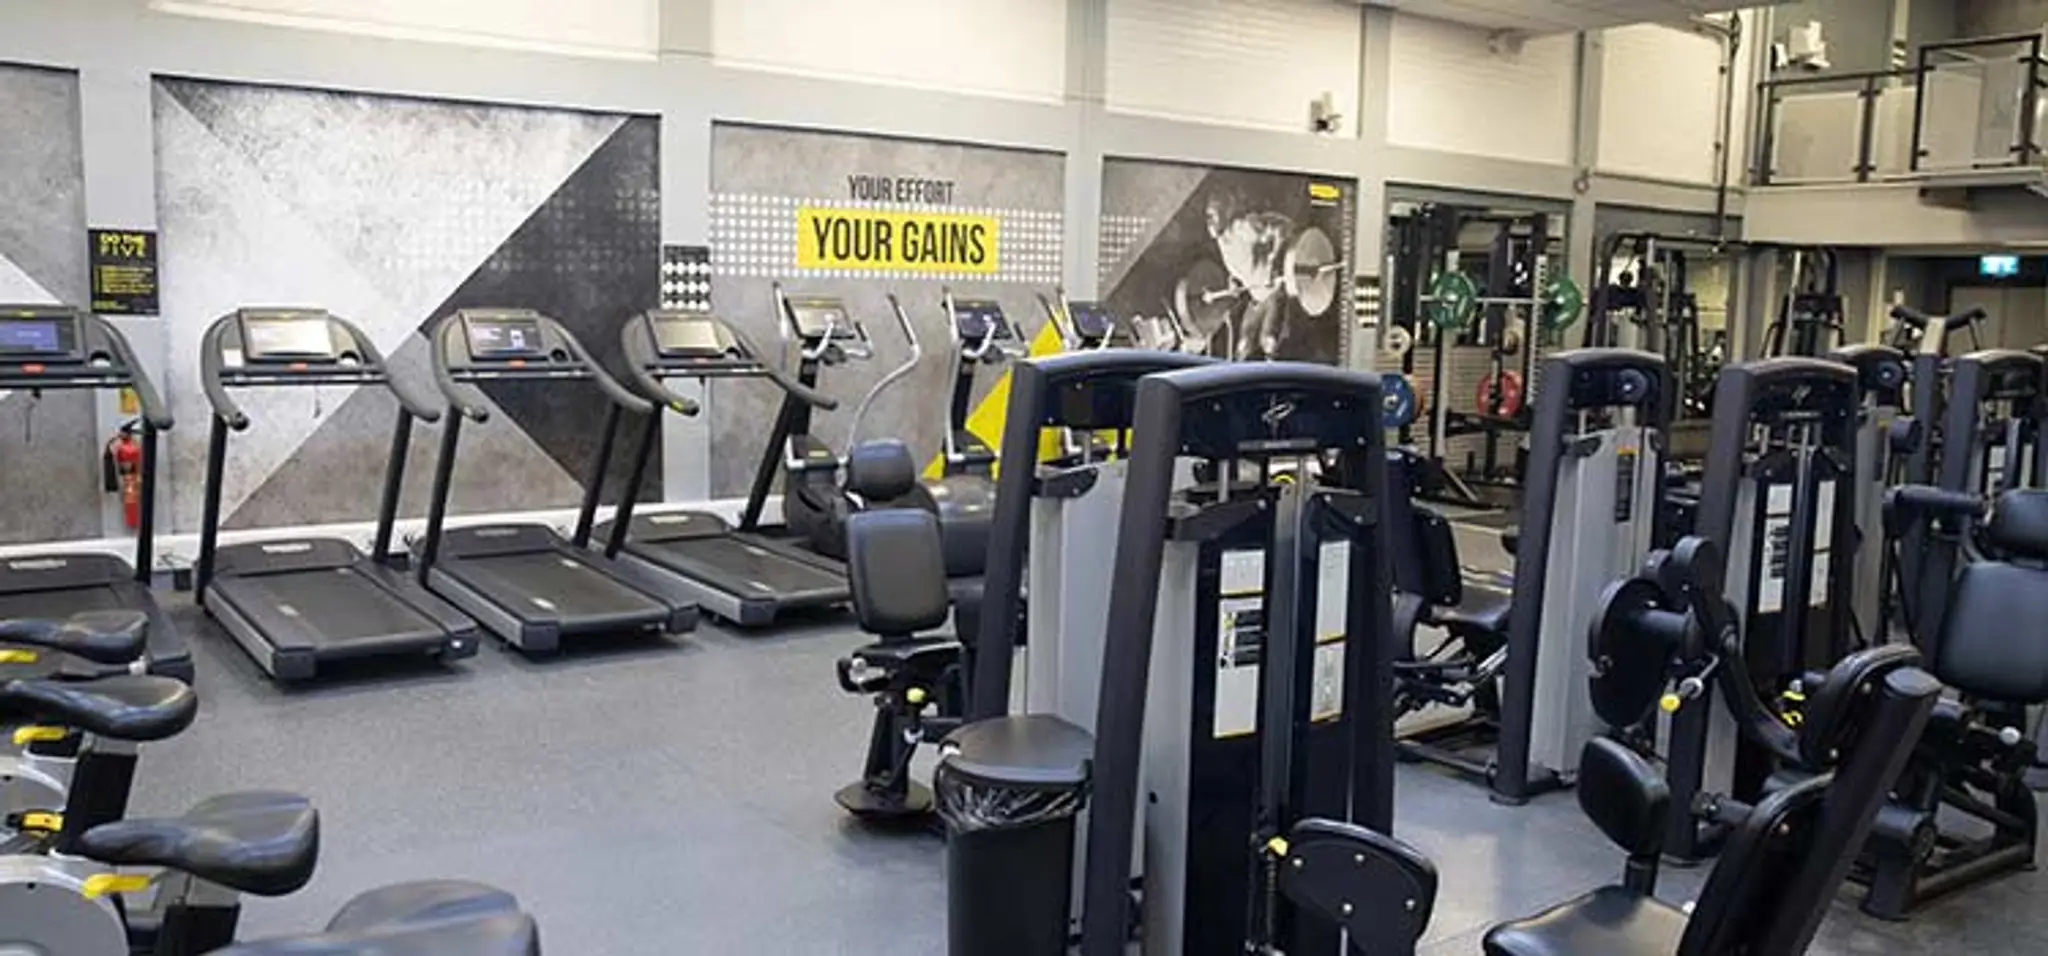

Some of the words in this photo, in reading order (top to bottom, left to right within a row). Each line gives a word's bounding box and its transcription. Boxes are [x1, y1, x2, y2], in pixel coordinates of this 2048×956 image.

[848, 175, 892, 200] YOUR
[896, 178, 954, 204] EFFORT
[812, 216, 892, 261] YOUR
[902, 220, 986, 265] GAINS
